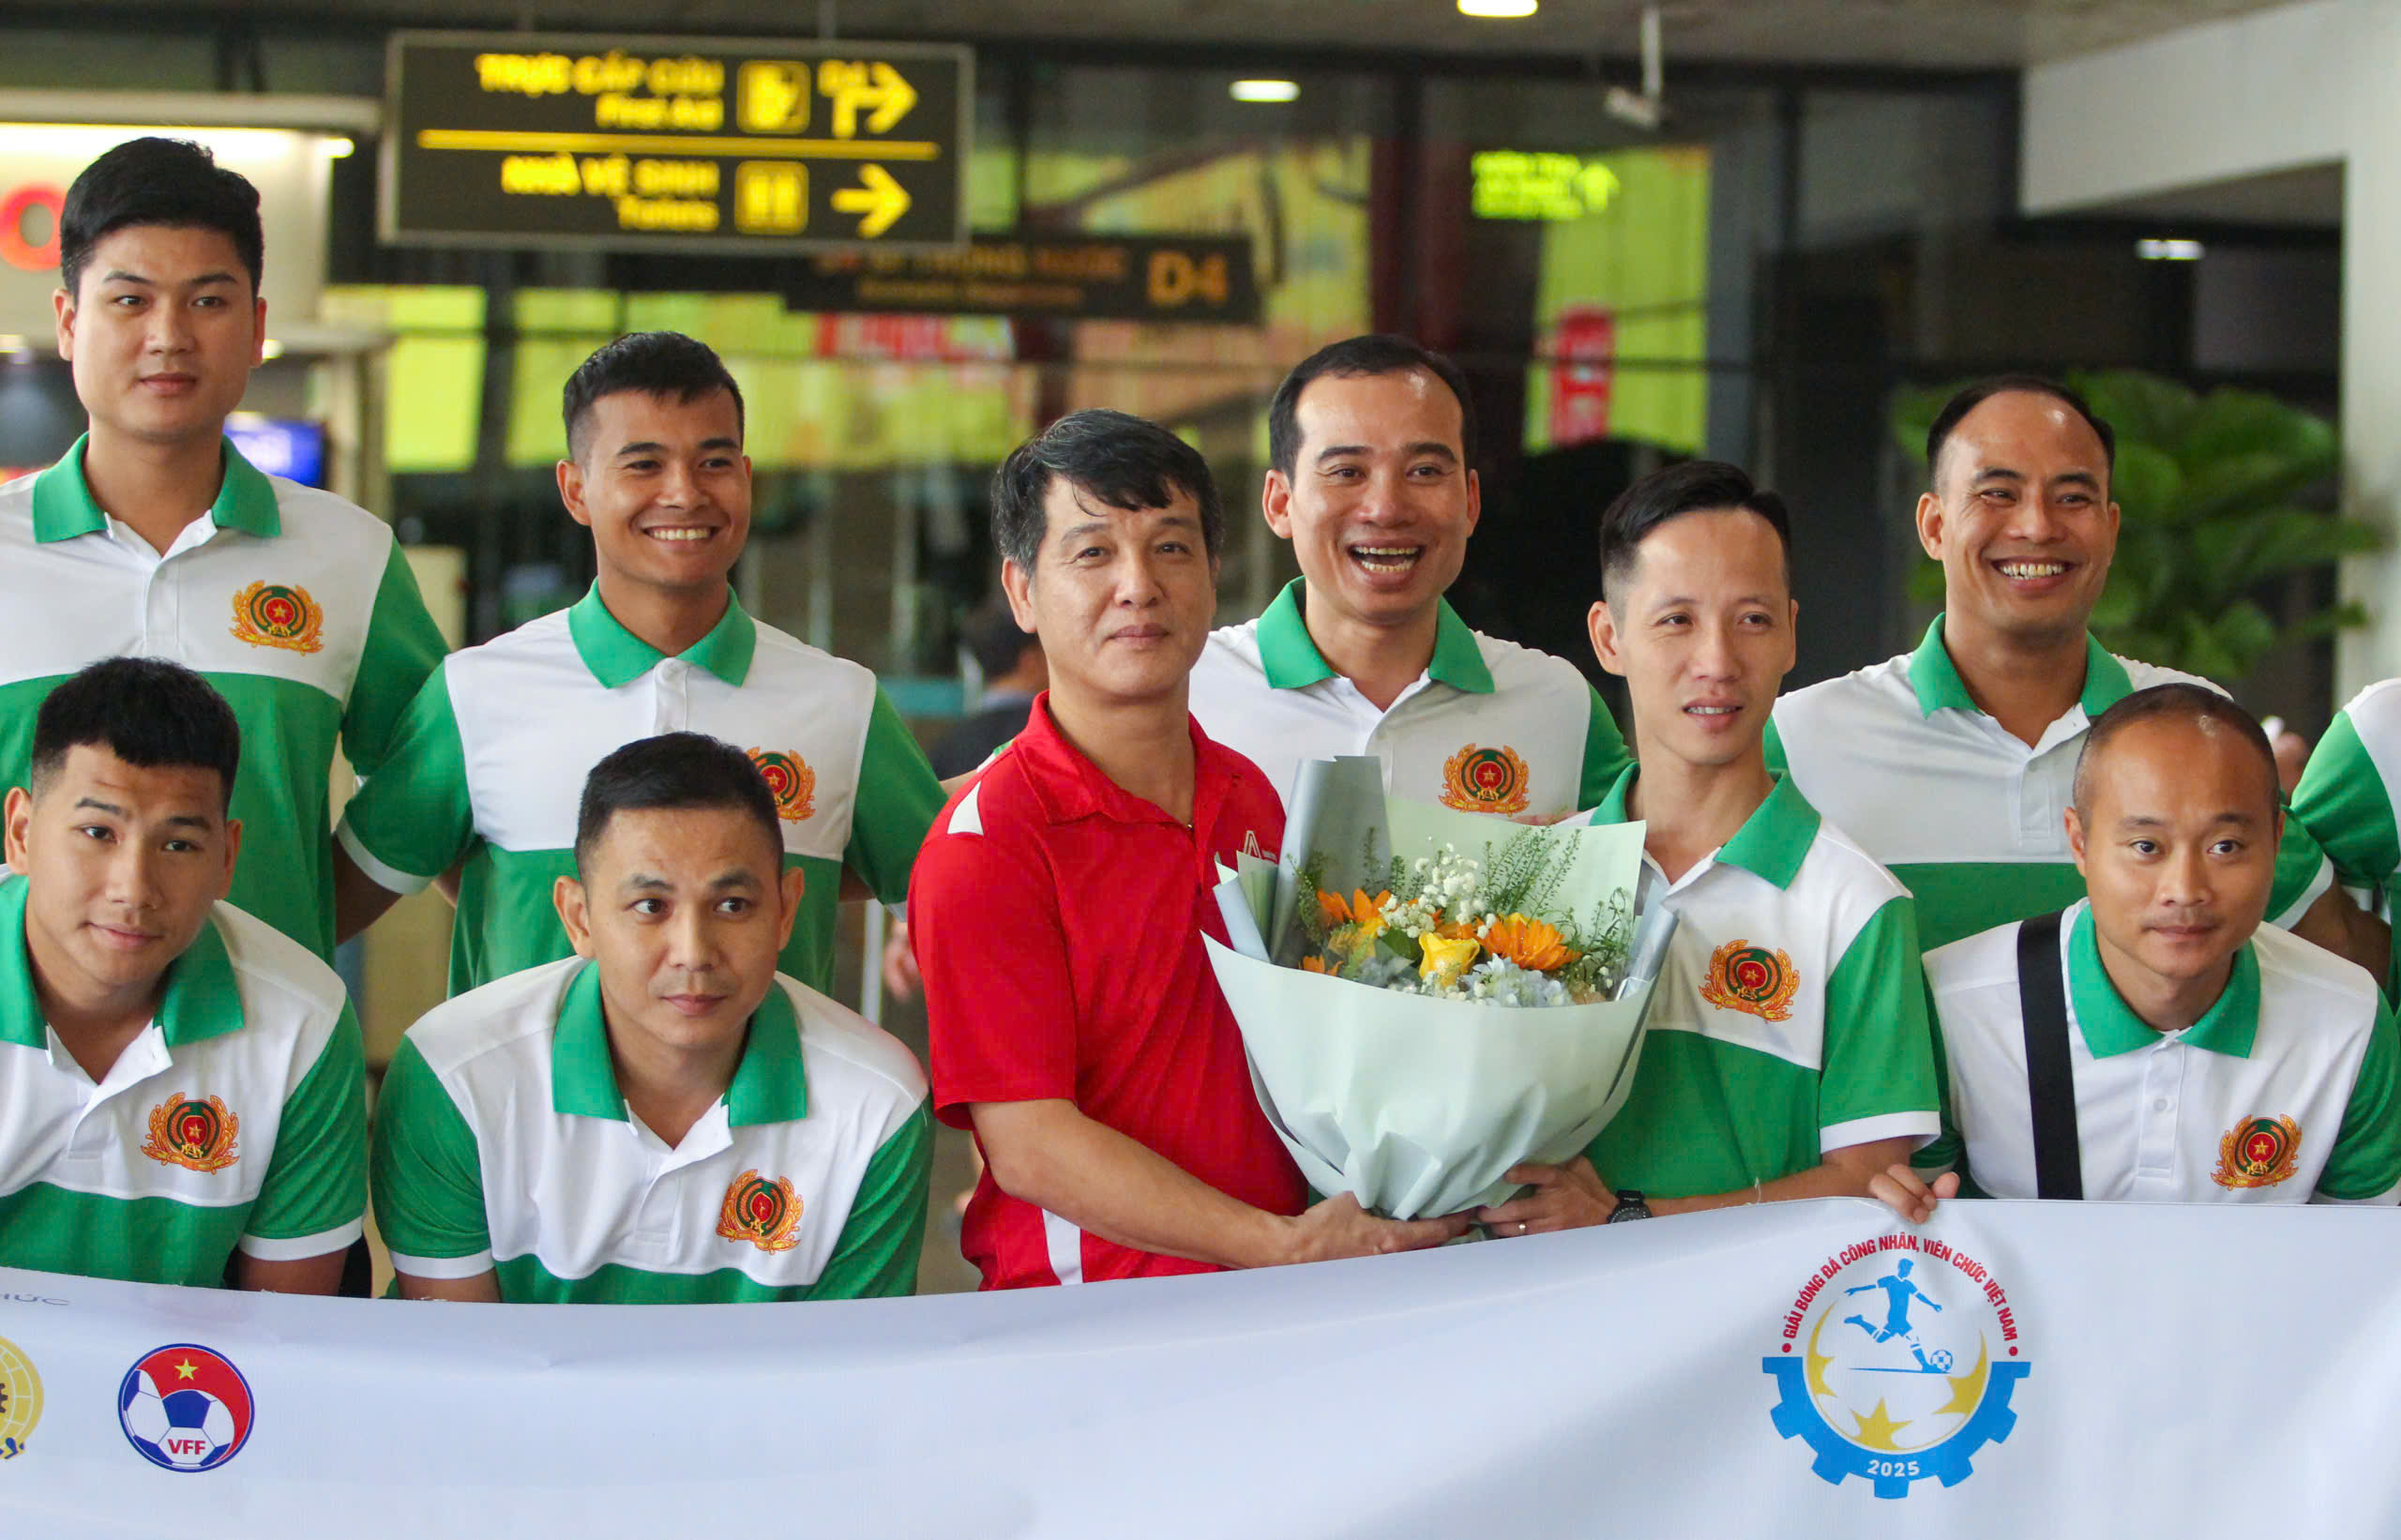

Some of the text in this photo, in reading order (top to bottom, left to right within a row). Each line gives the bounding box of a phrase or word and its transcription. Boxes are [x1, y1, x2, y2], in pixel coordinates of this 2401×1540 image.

[1148, 249, 1227, 305] D4
[1783, 1231, 2018, 1341] GIẢI BÓNG ĐÁ CÔNG NHÂN, VIÊN CHỨC VIỆT NAM
[168, 1439, 206, 1455] VFF
[1867, 1459, 1920, 1477] 2025
